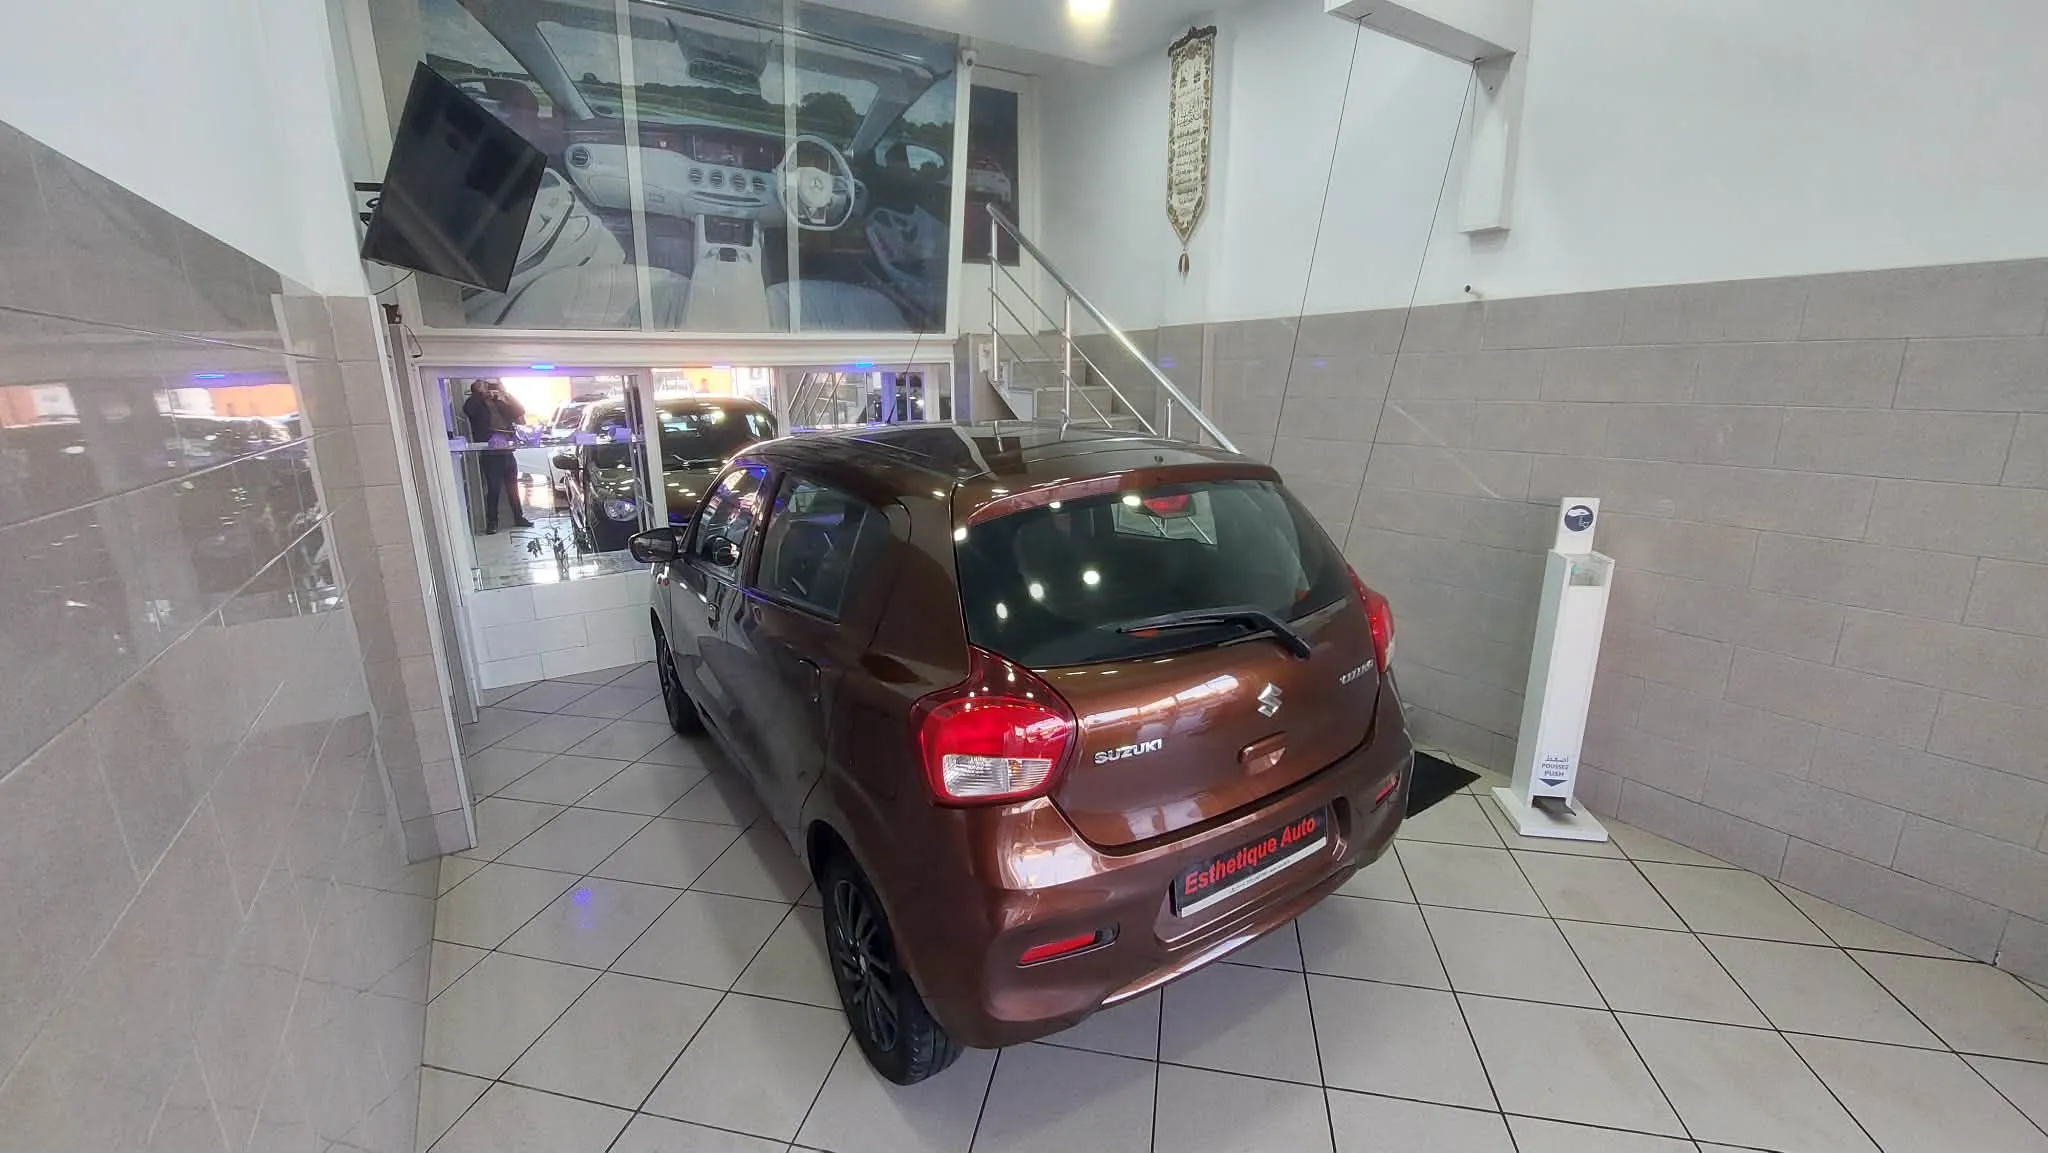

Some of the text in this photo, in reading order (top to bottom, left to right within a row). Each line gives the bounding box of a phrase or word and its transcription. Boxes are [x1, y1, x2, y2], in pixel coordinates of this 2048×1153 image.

[1094, 738, 1163, 764] SUZUKI
[1184, 837, 1277, 895] Esthetique
[1280, 817, 1317, 848] Auto
